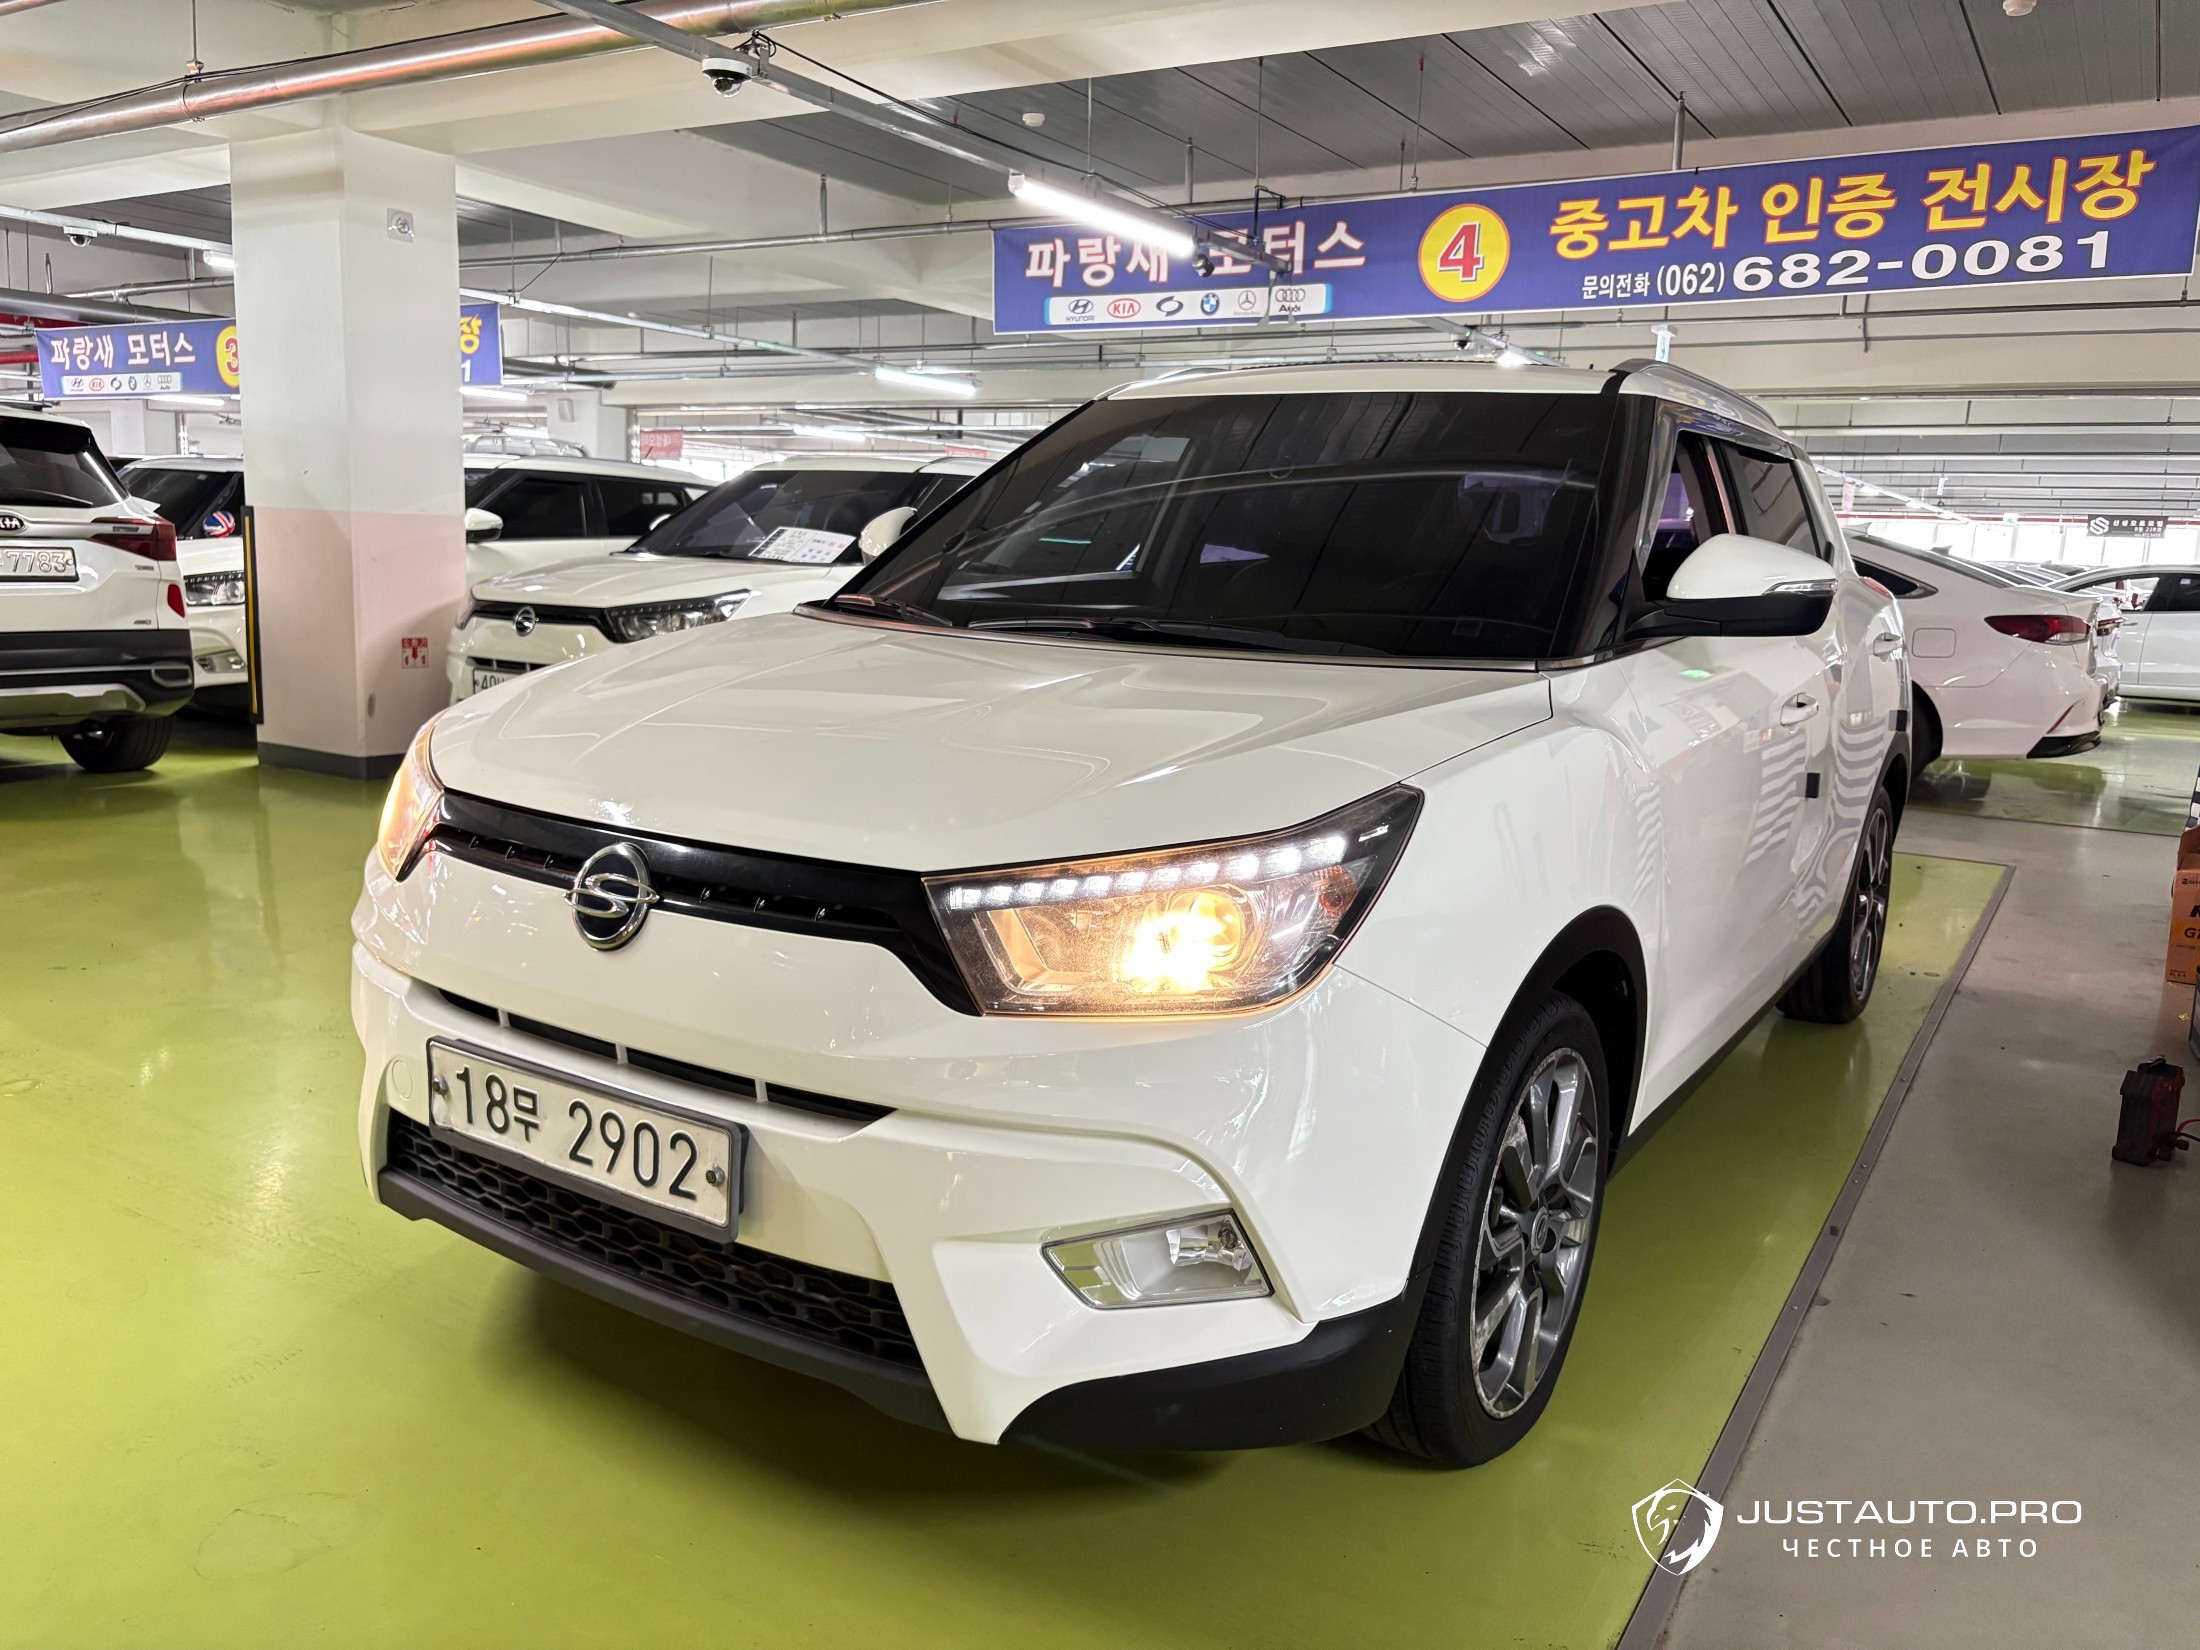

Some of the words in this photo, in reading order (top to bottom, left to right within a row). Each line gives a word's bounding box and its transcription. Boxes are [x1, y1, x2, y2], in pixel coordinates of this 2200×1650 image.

[1549, 184, 1738, 261] 중고차
[1760, 171, 1897, 248] 인증
[1922, 149, 2156, 233] 전시장
[1025, 232, 1169, 288] 파랑새
[1437, 222, 1484, 281] 4
[1582, 271, 1650, 300] 문의전화
[1656, 261, 1726, 296] (062)
[1732, 230, 2110, 292] 682-0081
[1065, 315, 1096, 323] HYUNDAI
[51, 334, 114, 371] 파랑새
[127, 330, 196, 367] 모터스
[225, 336, 240, 376] 3
[6, 550, 67, 573] 7783
[455, 1064, 541, 1143] 18무
[567, 1097, 699, 1201] 2902
